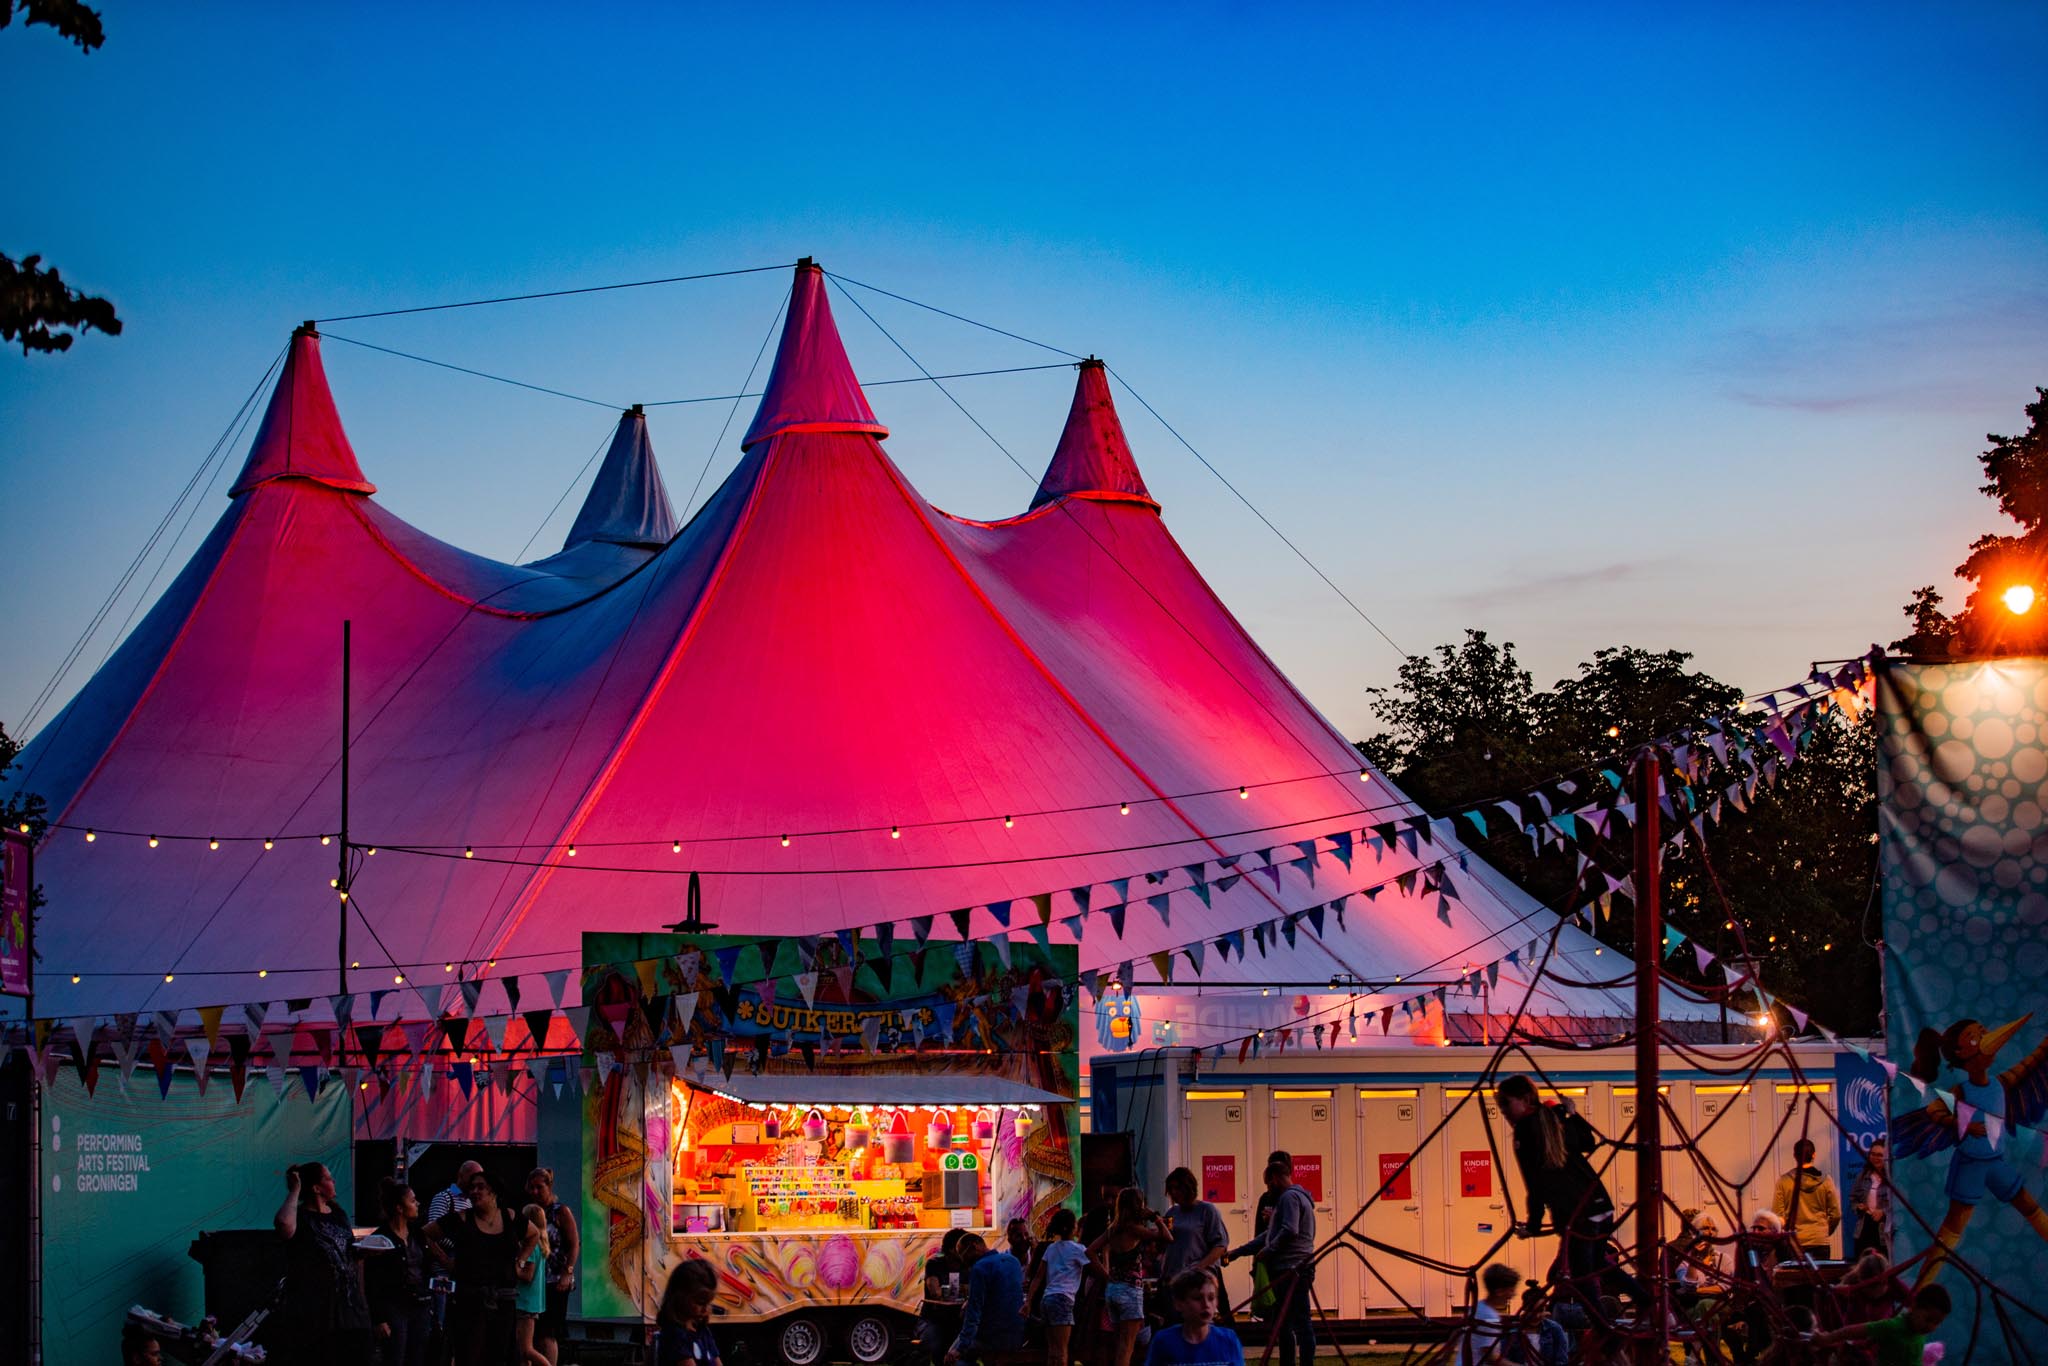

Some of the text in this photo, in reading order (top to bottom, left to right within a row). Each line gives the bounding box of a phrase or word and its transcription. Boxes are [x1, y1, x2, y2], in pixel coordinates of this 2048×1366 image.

[1313, 1109, 1325, 1117] WC
[1400, 1108, 1411, 1117] WC
[1623, 1105, 1634, 1114] WC
[1705, 1104, 1716, 1113] WC
[1228, 1110, 1240, 1118] WC
[77, 1134, 142, 1152] PERFORMING
[77, 1154, 150, 1171] ARTS FESTIVAL
[1206, 1164, 1234, 1172] KINDER
[1464, 1166, 1477, 1174] WC
[77, 1174, 138, 1192] GRONINGEN
